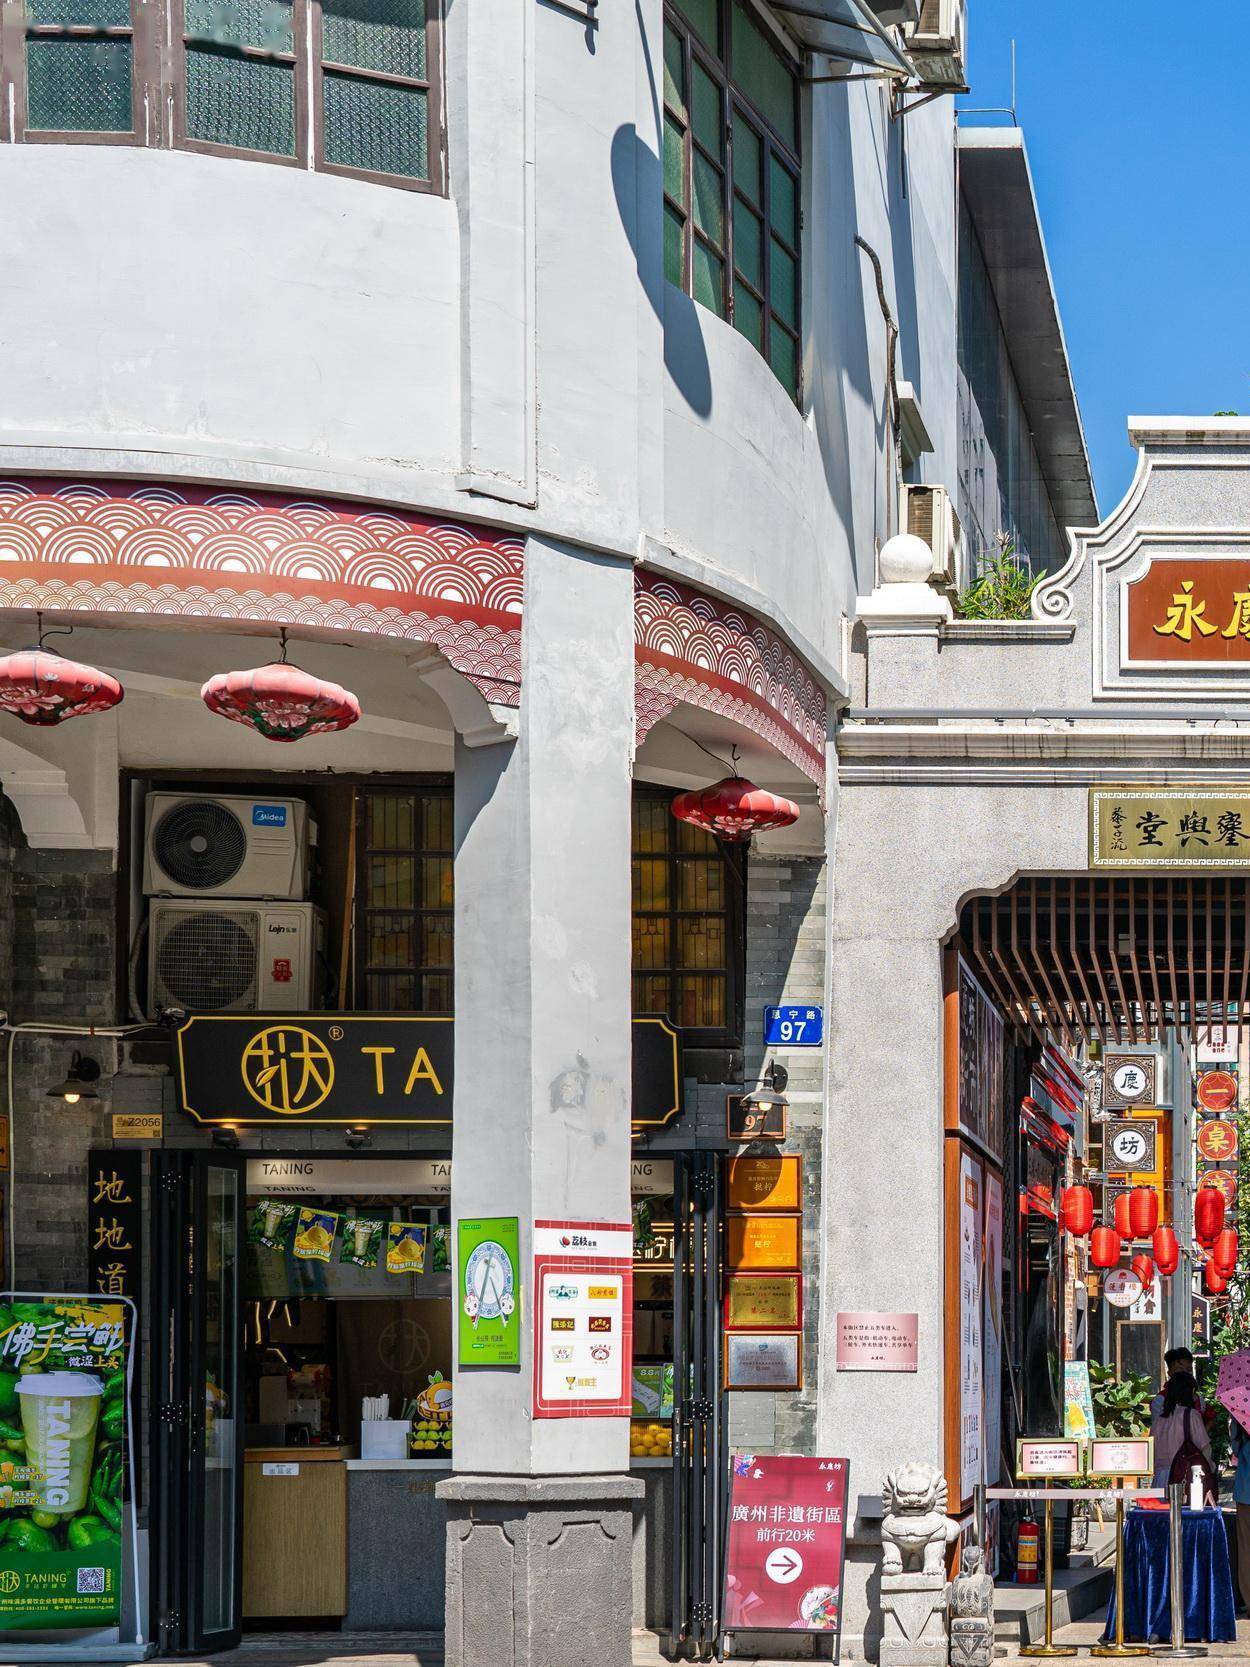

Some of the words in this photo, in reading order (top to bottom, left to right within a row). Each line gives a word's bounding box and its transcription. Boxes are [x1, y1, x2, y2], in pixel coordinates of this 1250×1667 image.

[256, 810, 284, 821] Midea
[771, 1010, 816, 1020] 恩宁路
[780, 1021, 807, 1041] 97
[128, 1118, 161, 1128] Z2056
[744, 1115, 768, 1132] 97
[1120, 1136, 1140, 1156] 坊
[262, 1163, 313, 1175] TANING
[93, 1170, 133, 1294] 地地道
[46, 1400, 71, 1506] TANING
[731, 1504, 842, 1524] 廣州非遺街區
[756, 1528, 815, 1542] 前行20米
[24, 1573, 67, 1583] TANING
